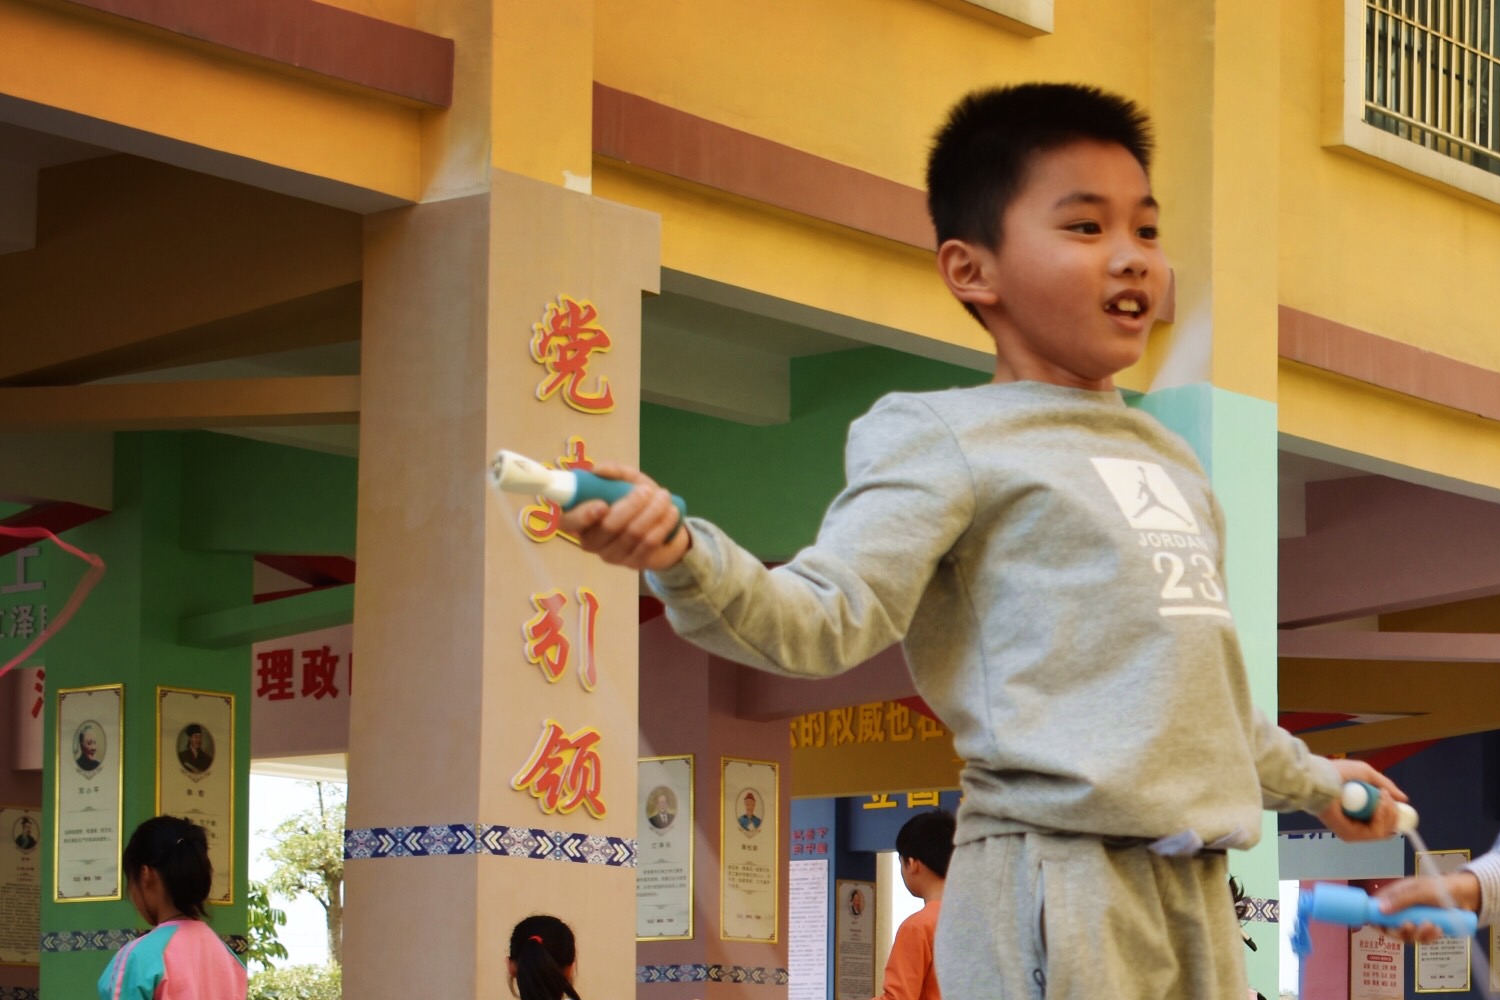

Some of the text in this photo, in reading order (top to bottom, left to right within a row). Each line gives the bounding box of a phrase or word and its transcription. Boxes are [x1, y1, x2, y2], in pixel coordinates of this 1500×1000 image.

[1139, 531, 1209, 551] JORDAN
[1153, 551, 1223, 602] 23
[256, 645, 353, 701] 理政
